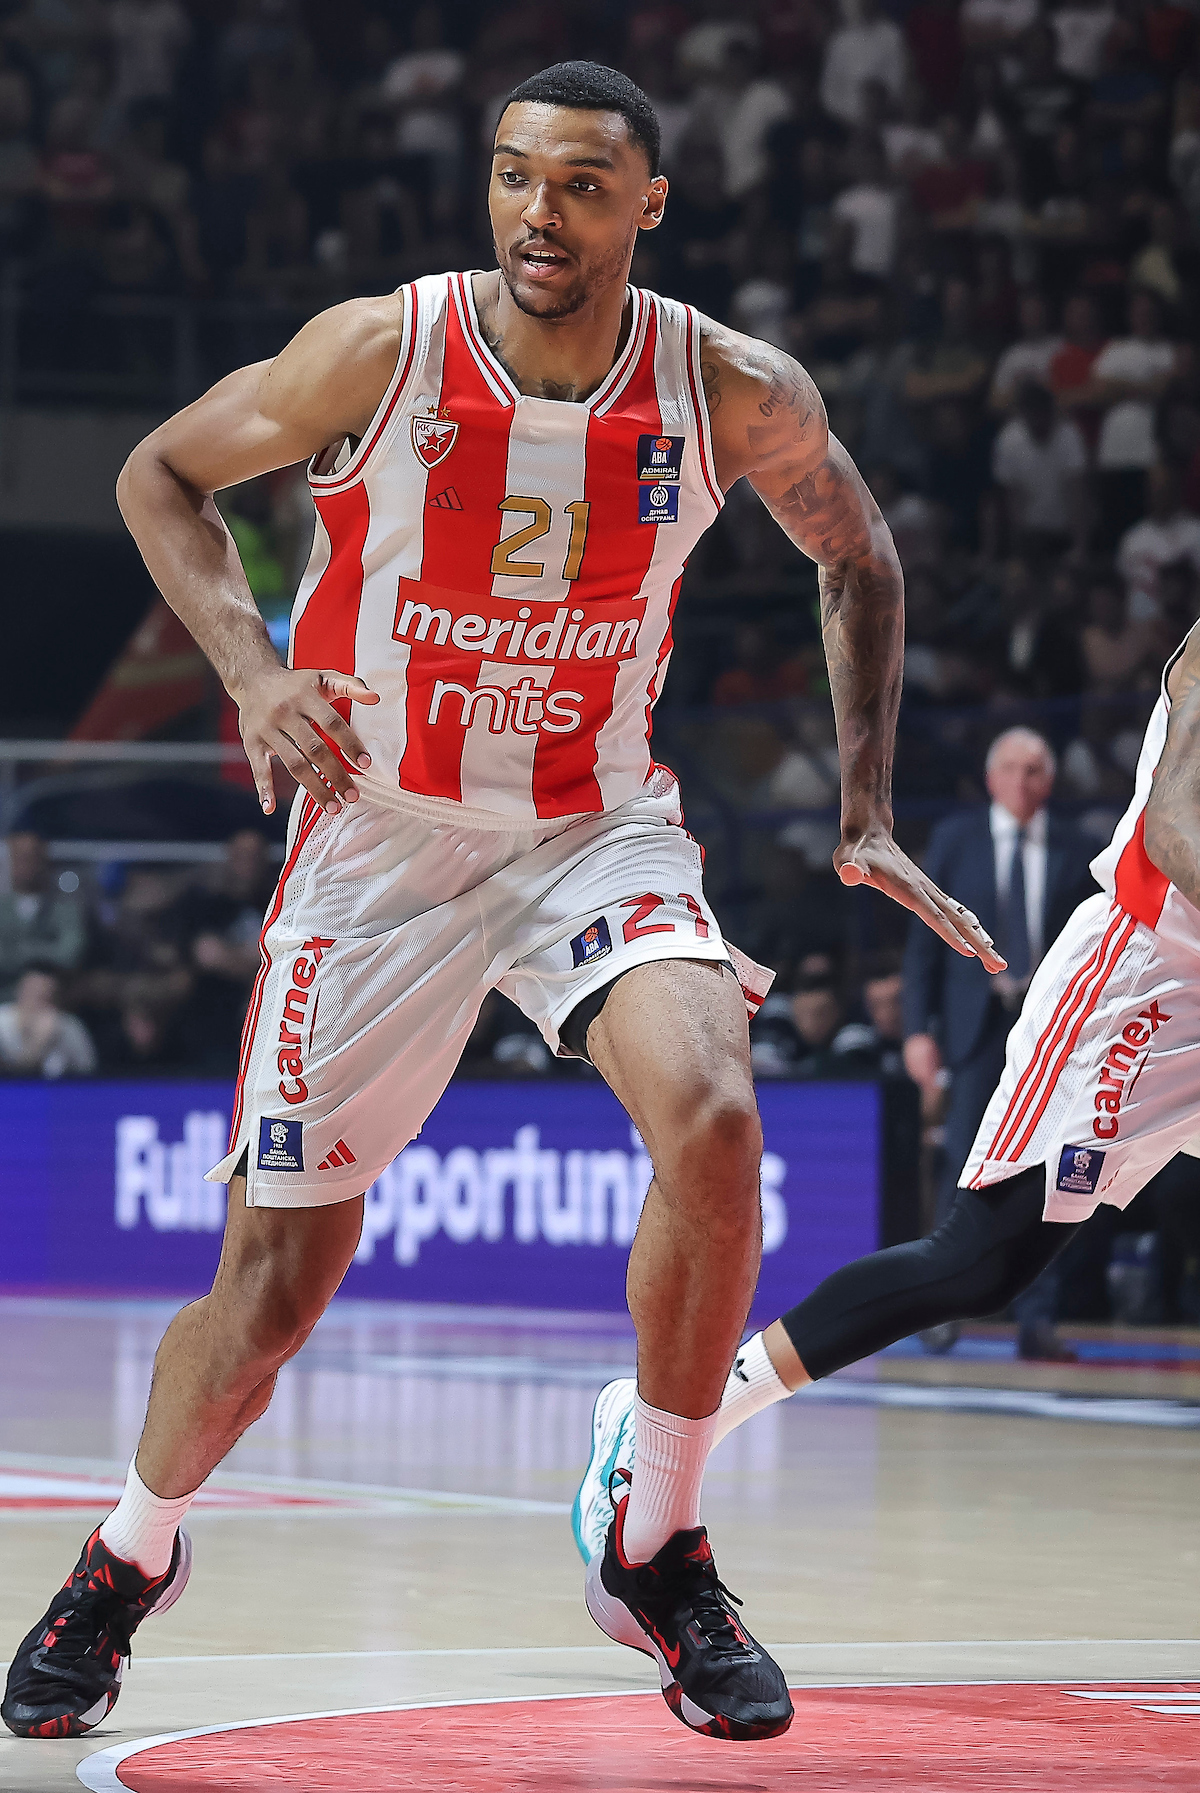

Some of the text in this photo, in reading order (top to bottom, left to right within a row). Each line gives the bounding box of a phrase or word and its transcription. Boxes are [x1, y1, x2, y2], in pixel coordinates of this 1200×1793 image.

[641, 466, 678, 474] ADMIRAL
[651, 451, 667, 464] ABA
[489, 494, 591, 581] 21
[396, 599, 640, 660] meridian
[428, 677, 585, 733] mts
[619, 891, 710, 945] 21
[585, 939, 600, 957] ABA
[277, 936, 337, 1105] carnex
[1092, 999, 1173, 1140] carnex
[115, 1109, 227, 1230] Full
